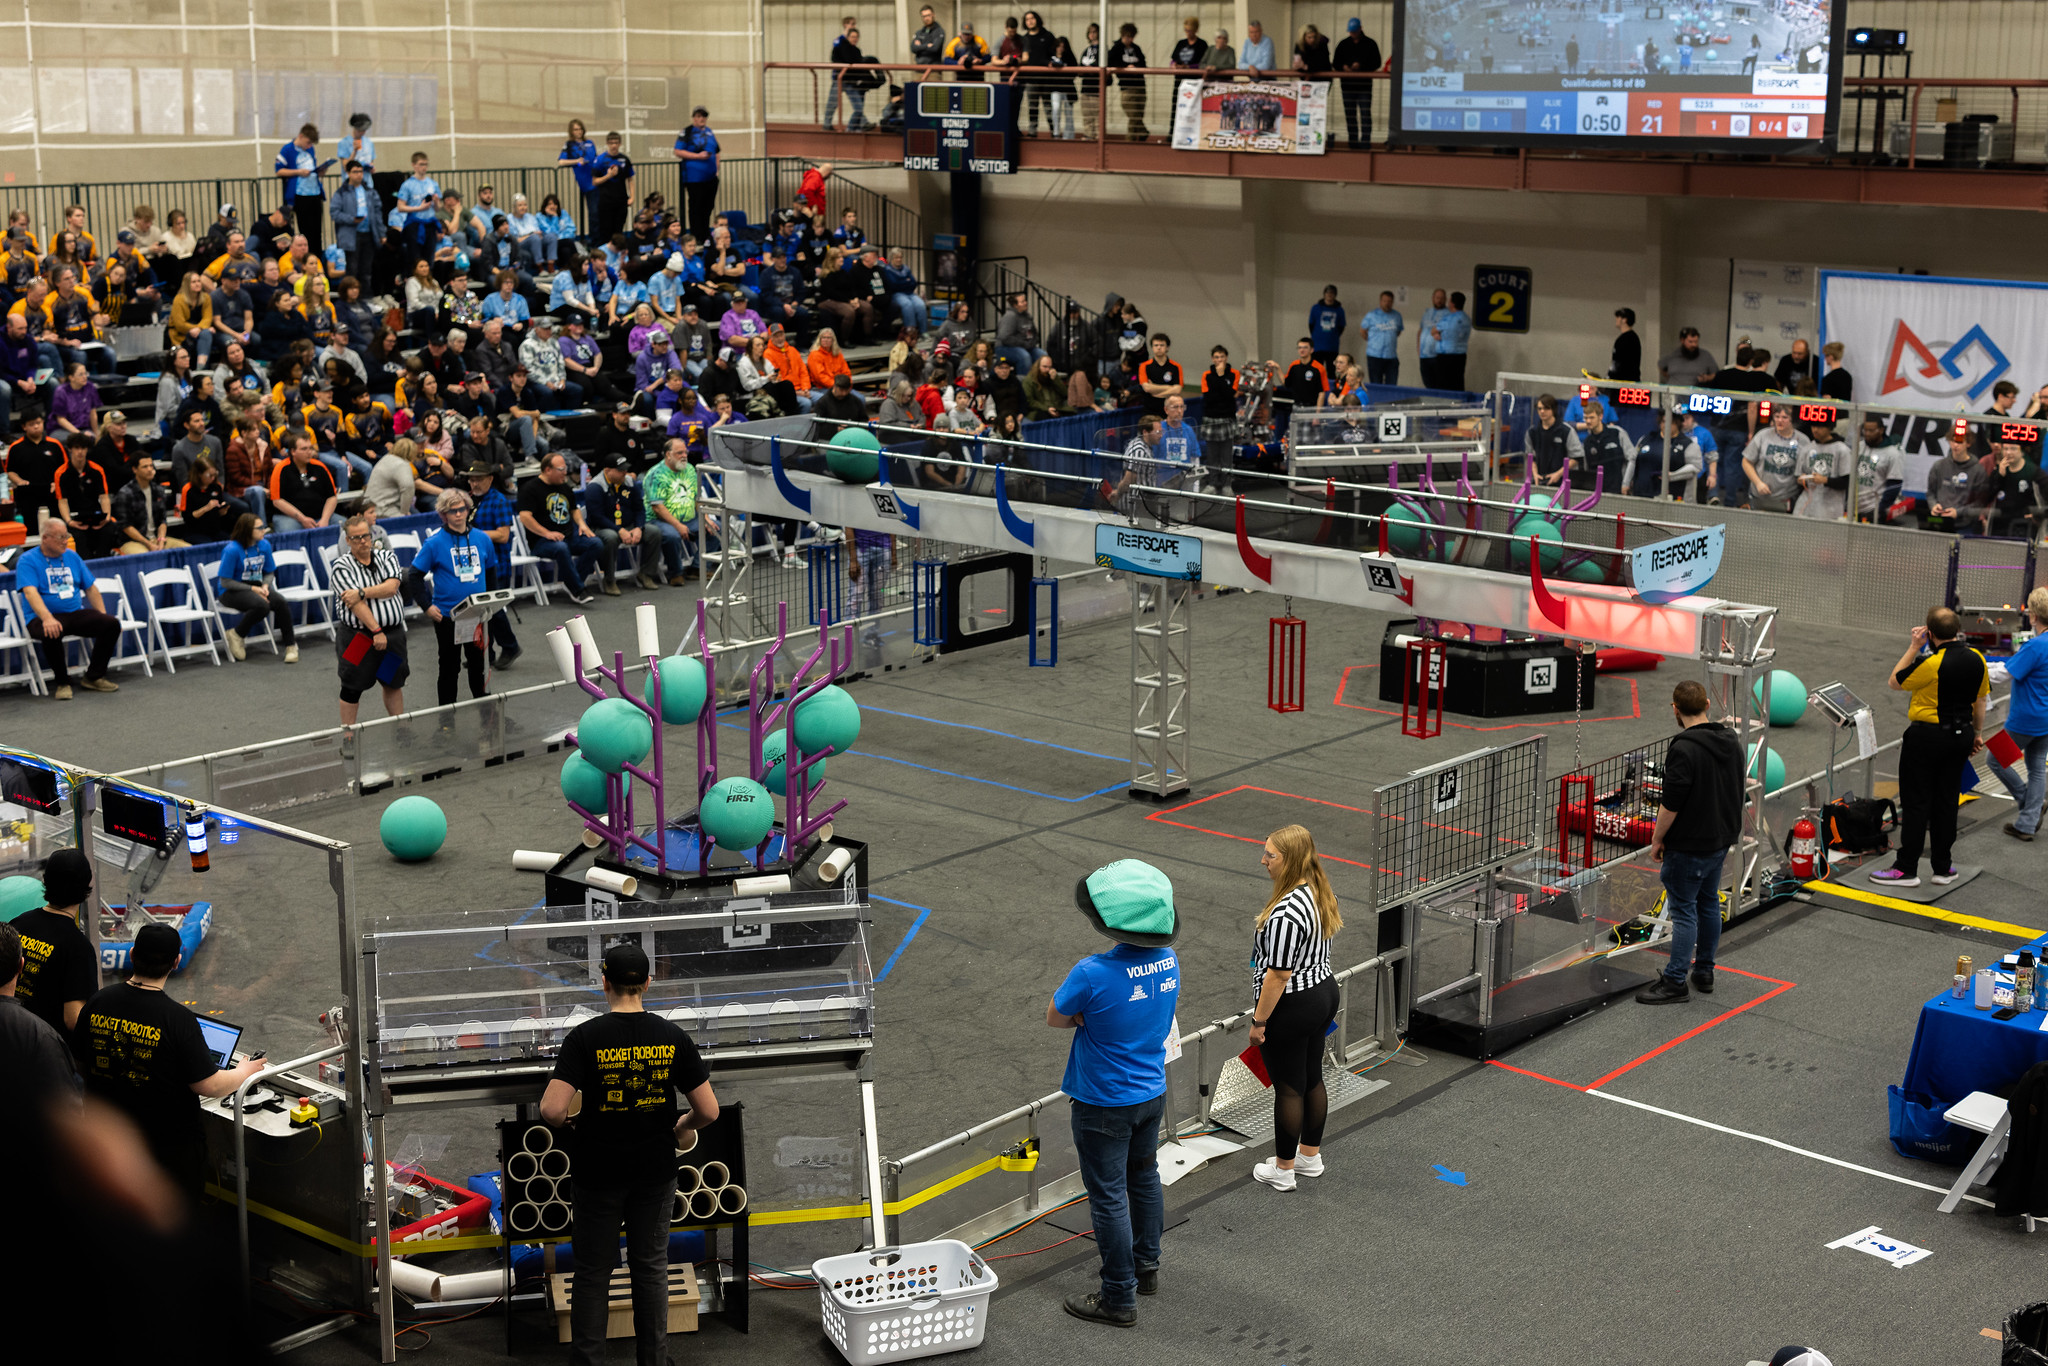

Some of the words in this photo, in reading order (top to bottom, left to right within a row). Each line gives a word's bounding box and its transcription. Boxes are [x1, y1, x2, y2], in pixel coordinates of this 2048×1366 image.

[1420, 77, 1447, 88] DIVE
[1561, 79, 1611, 89] Qualification
[1624, 79, 1634, 88] of
[1646, 99, 1662, 109] RED
[942, 118, 970, 129] BONUS
[1437, 115, 1457, 126] 1/4
[1492, 116, 1499, 127] 1
[1540, 113, 1562, 132] 41
[1582, 114, 1621, 132] 0:50
[1641, 115, 1663, 134] 21
[1709, 119, 1718, 131] 1
[1758, 120, 1783, 133] 0/4
[1207, 135, 1246, 149] TEAM
[1248, 136, 1290, 151] 4994
[904, 156, 940, 171] HOME
[968, 158, 1010, 173] VISITOR
[1478, 273, 1528, 291] COURT
[1488, 290, 1515, 324] 2
[1618, 387, 1650, 406] 8385
[1689, 393, 1732, 415] 00:50
[1799, 404, 1837, 423] 10667
[2001, 422, 2038, 442] 5235
[1116, 531, 1180, 556] REEFSCAPE
[1651, 535, 1709, 572] REEFSCAPE
[726, 794, 756, 804] FIRST
[20, 935, 54, 958] ROBOTICS
[1126, 956, 1176, 979] VOLUNTEER
[90, 1013, 121, 1031] ROCKET
[120, 1019, 162, 1041] ROBOTICS
[596, 1047, 633, 1063] ROCKET
[632, 1045, 676, 1060] ROBOTICS
[598, 1061, 626, 1070] SPONSORS
[1914, 1140, 1952, 1154] meijer
